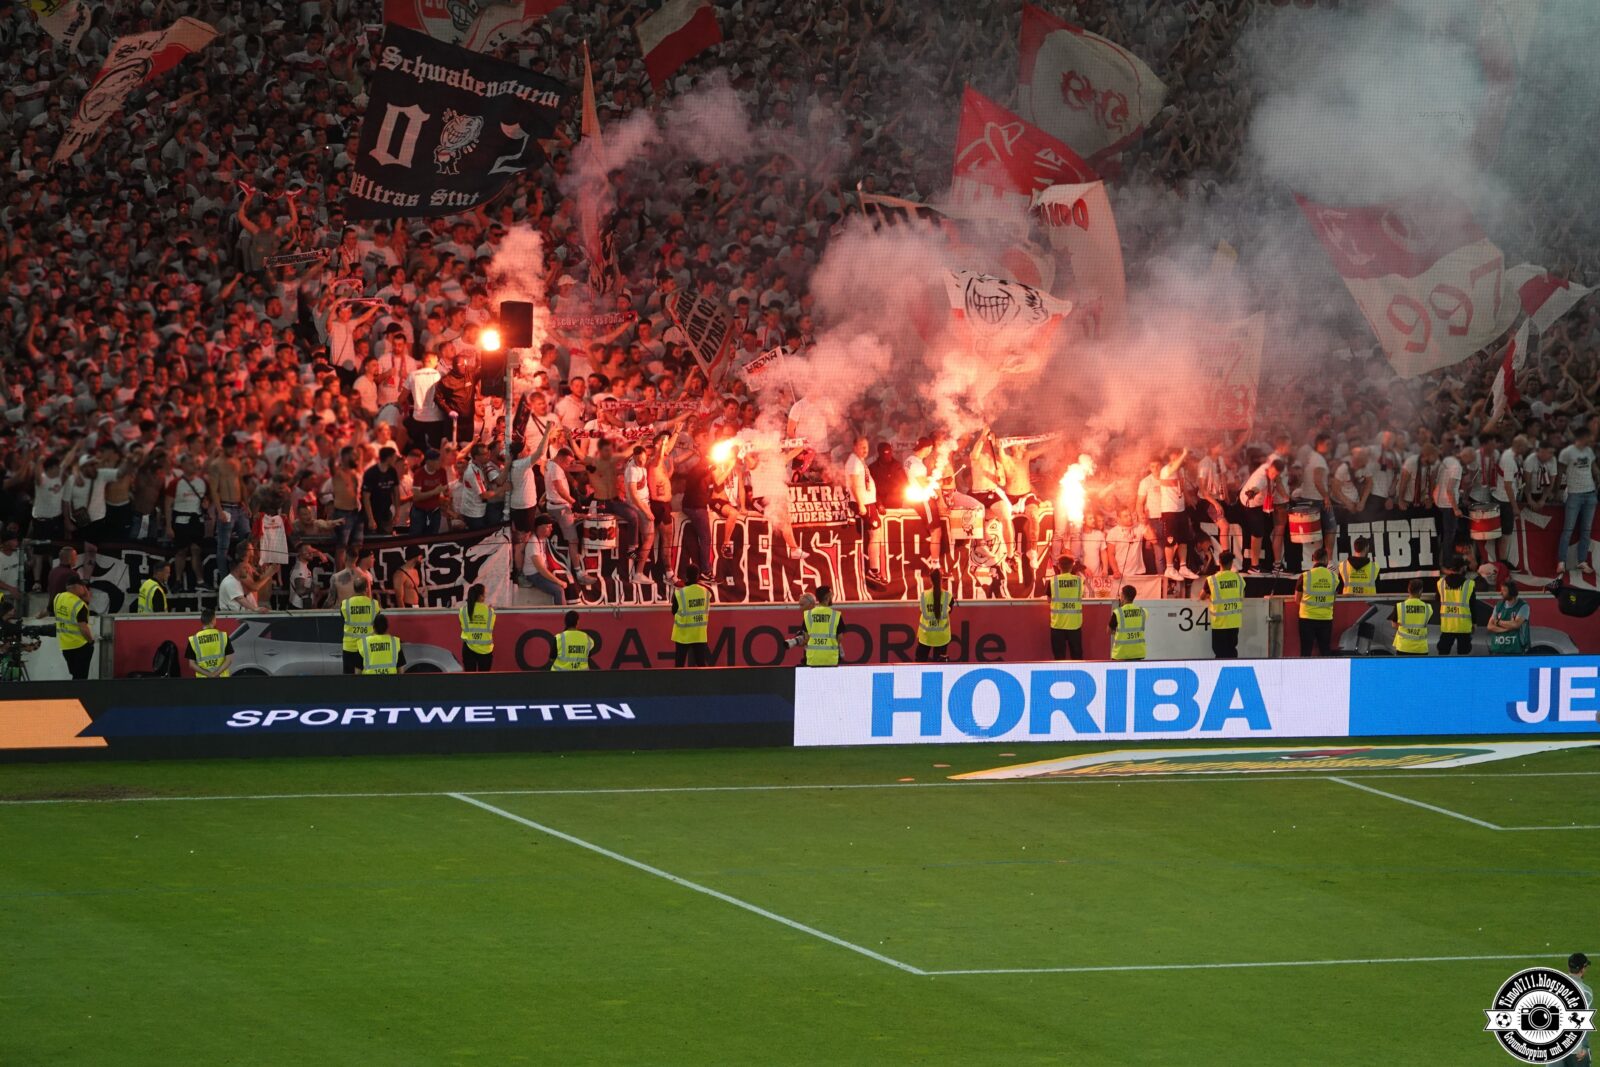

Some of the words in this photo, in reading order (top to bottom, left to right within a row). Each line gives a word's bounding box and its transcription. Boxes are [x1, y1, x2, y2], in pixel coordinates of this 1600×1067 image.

[349, 172, 419, 207] Ultras
[1059, 579, 1078, 588] SECURITY
[1220, 580, 1238, 589] SECURITY
[350, 605, 370, 615] SECURITY
[1124, 608, 1142, 618] SECURITY
[1406, 605, 1425, 613] SECURITY
[198, 633, 218, 644] SECURITY
[1495, 636, 1517, 645] HOST
[370, 642, 391, 652] SECURITY
[871, 665, 1271, 739] HORIBA
[227, 703, 636, 728] SPORTWETTEN
